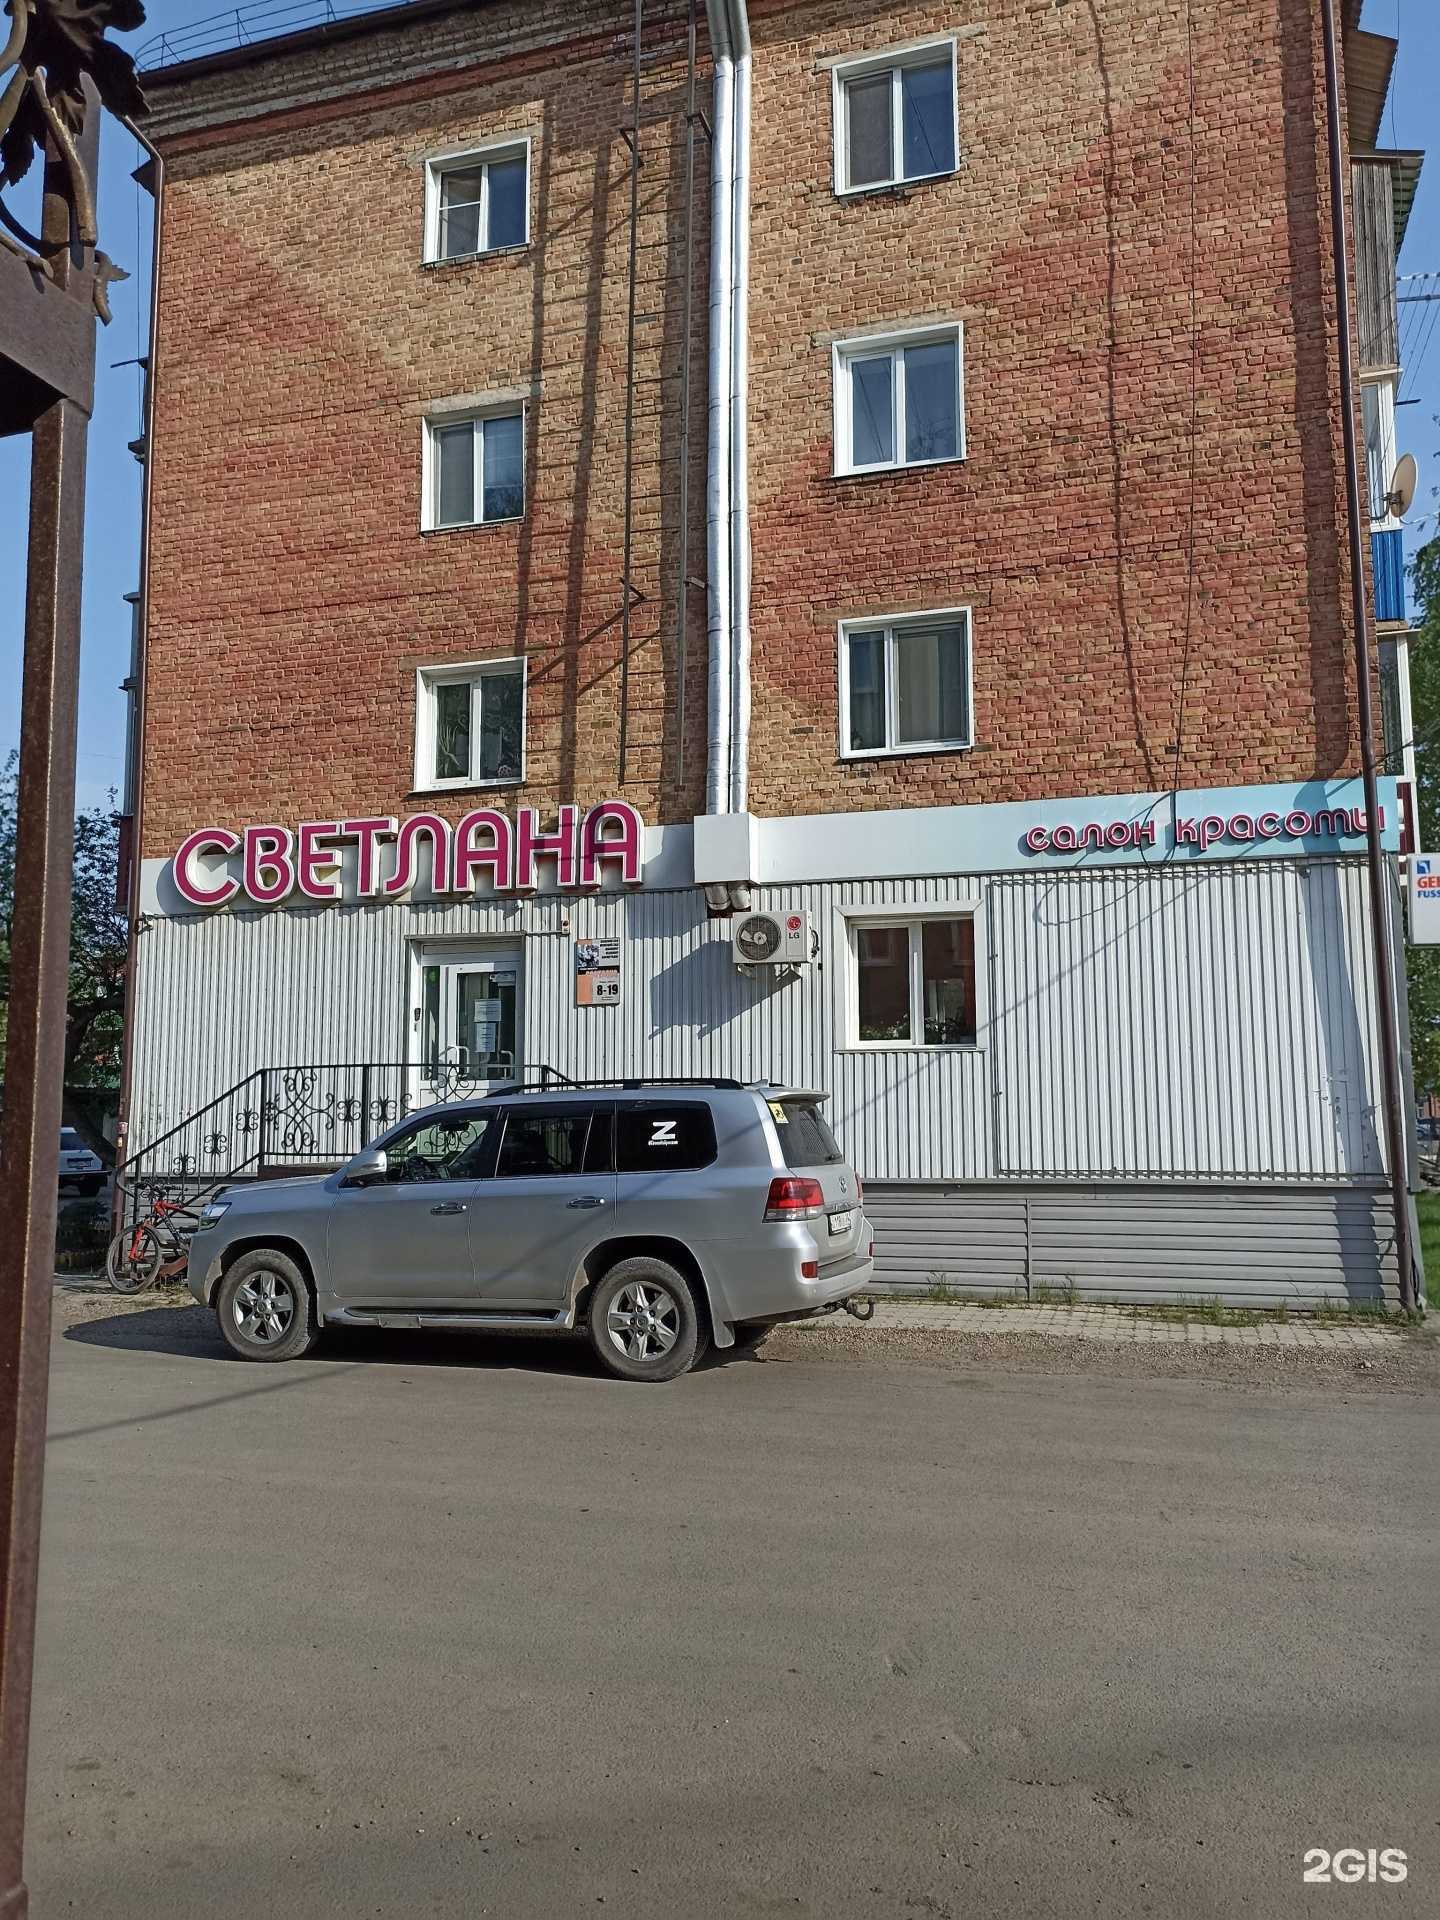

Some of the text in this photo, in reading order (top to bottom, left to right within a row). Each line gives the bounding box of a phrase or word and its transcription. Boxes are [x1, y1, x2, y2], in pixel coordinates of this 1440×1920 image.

[1026, 804, 1386, 852] салон красоты
[173, 800, 646, 906] СВЕТЛАНА
[1417, 876, 1440, 889] GE
[596, 984, 619, 996] 8-19
[651, 1121, 677, 1140] Z
